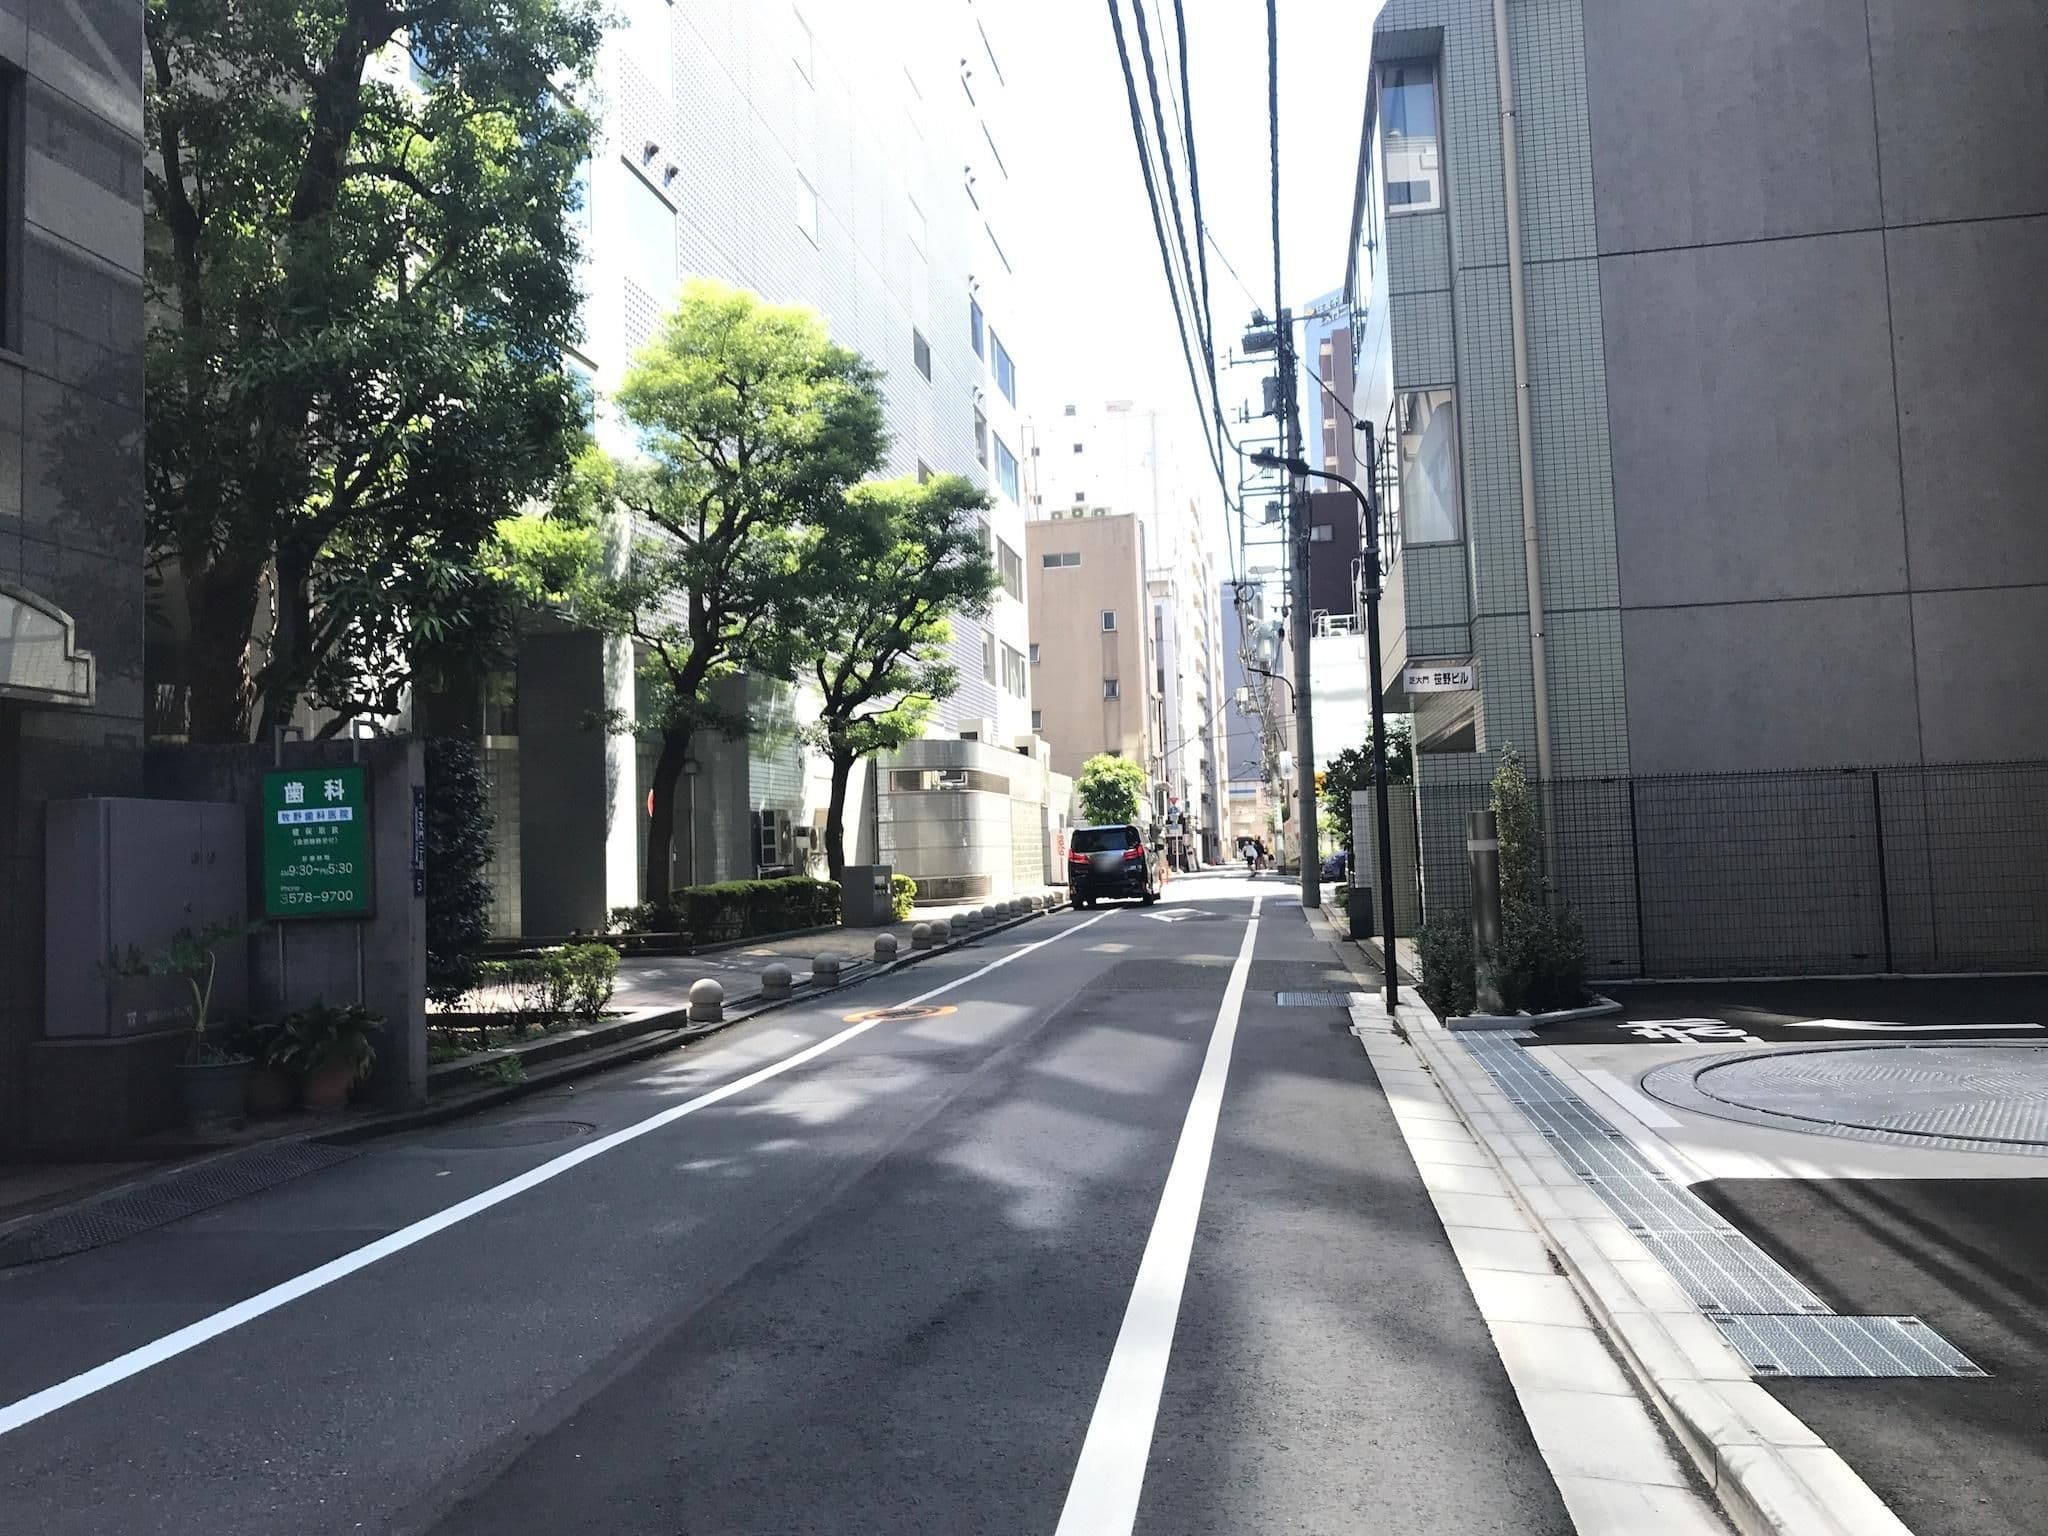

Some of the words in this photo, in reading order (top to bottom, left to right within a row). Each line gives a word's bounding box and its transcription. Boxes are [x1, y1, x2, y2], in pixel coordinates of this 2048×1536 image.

[1434, 672, 1468, 685] 笹野ビル
[284, 778, 345, 804] 歯科
[281, 809, 350, 823] 牧野歯科医院
[280, 890, 353, 904] 3578-9700
